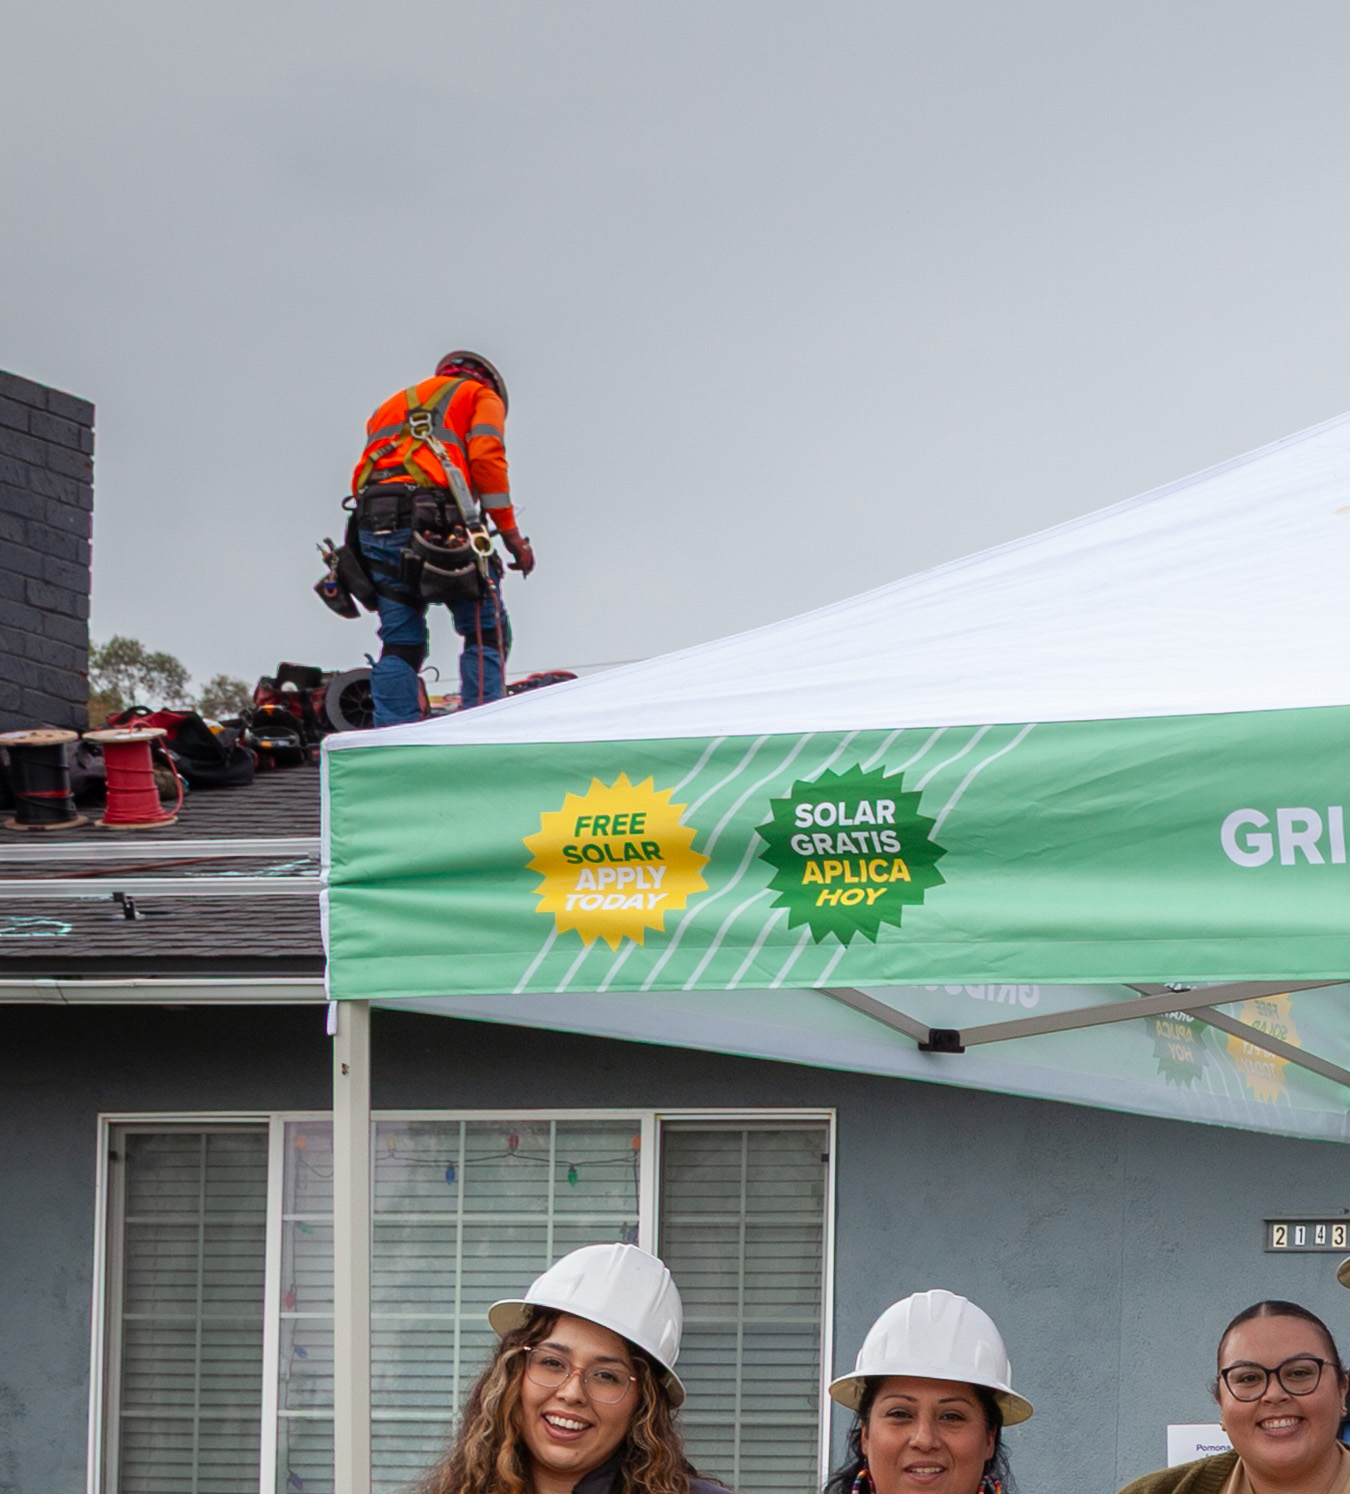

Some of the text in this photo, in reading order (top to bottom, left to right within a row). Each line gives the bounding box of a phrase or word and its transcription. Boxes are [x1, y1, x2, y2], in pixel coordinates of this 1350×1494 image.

[574, 812, 647, 838] FREE
[795, 799, 897, 828] SOLAR
[562, 840, 665, 865] SOLAR
[790, 829, 901, 856] GRATIS
[575, 865, 668, 892] APPLY
[801, 858, 912, 885] APLICA
[565, 892, 669, 912] TODAY
[815, 888, 888, 907] HOY
[1275, 1226, 1345, 1246] 2143
